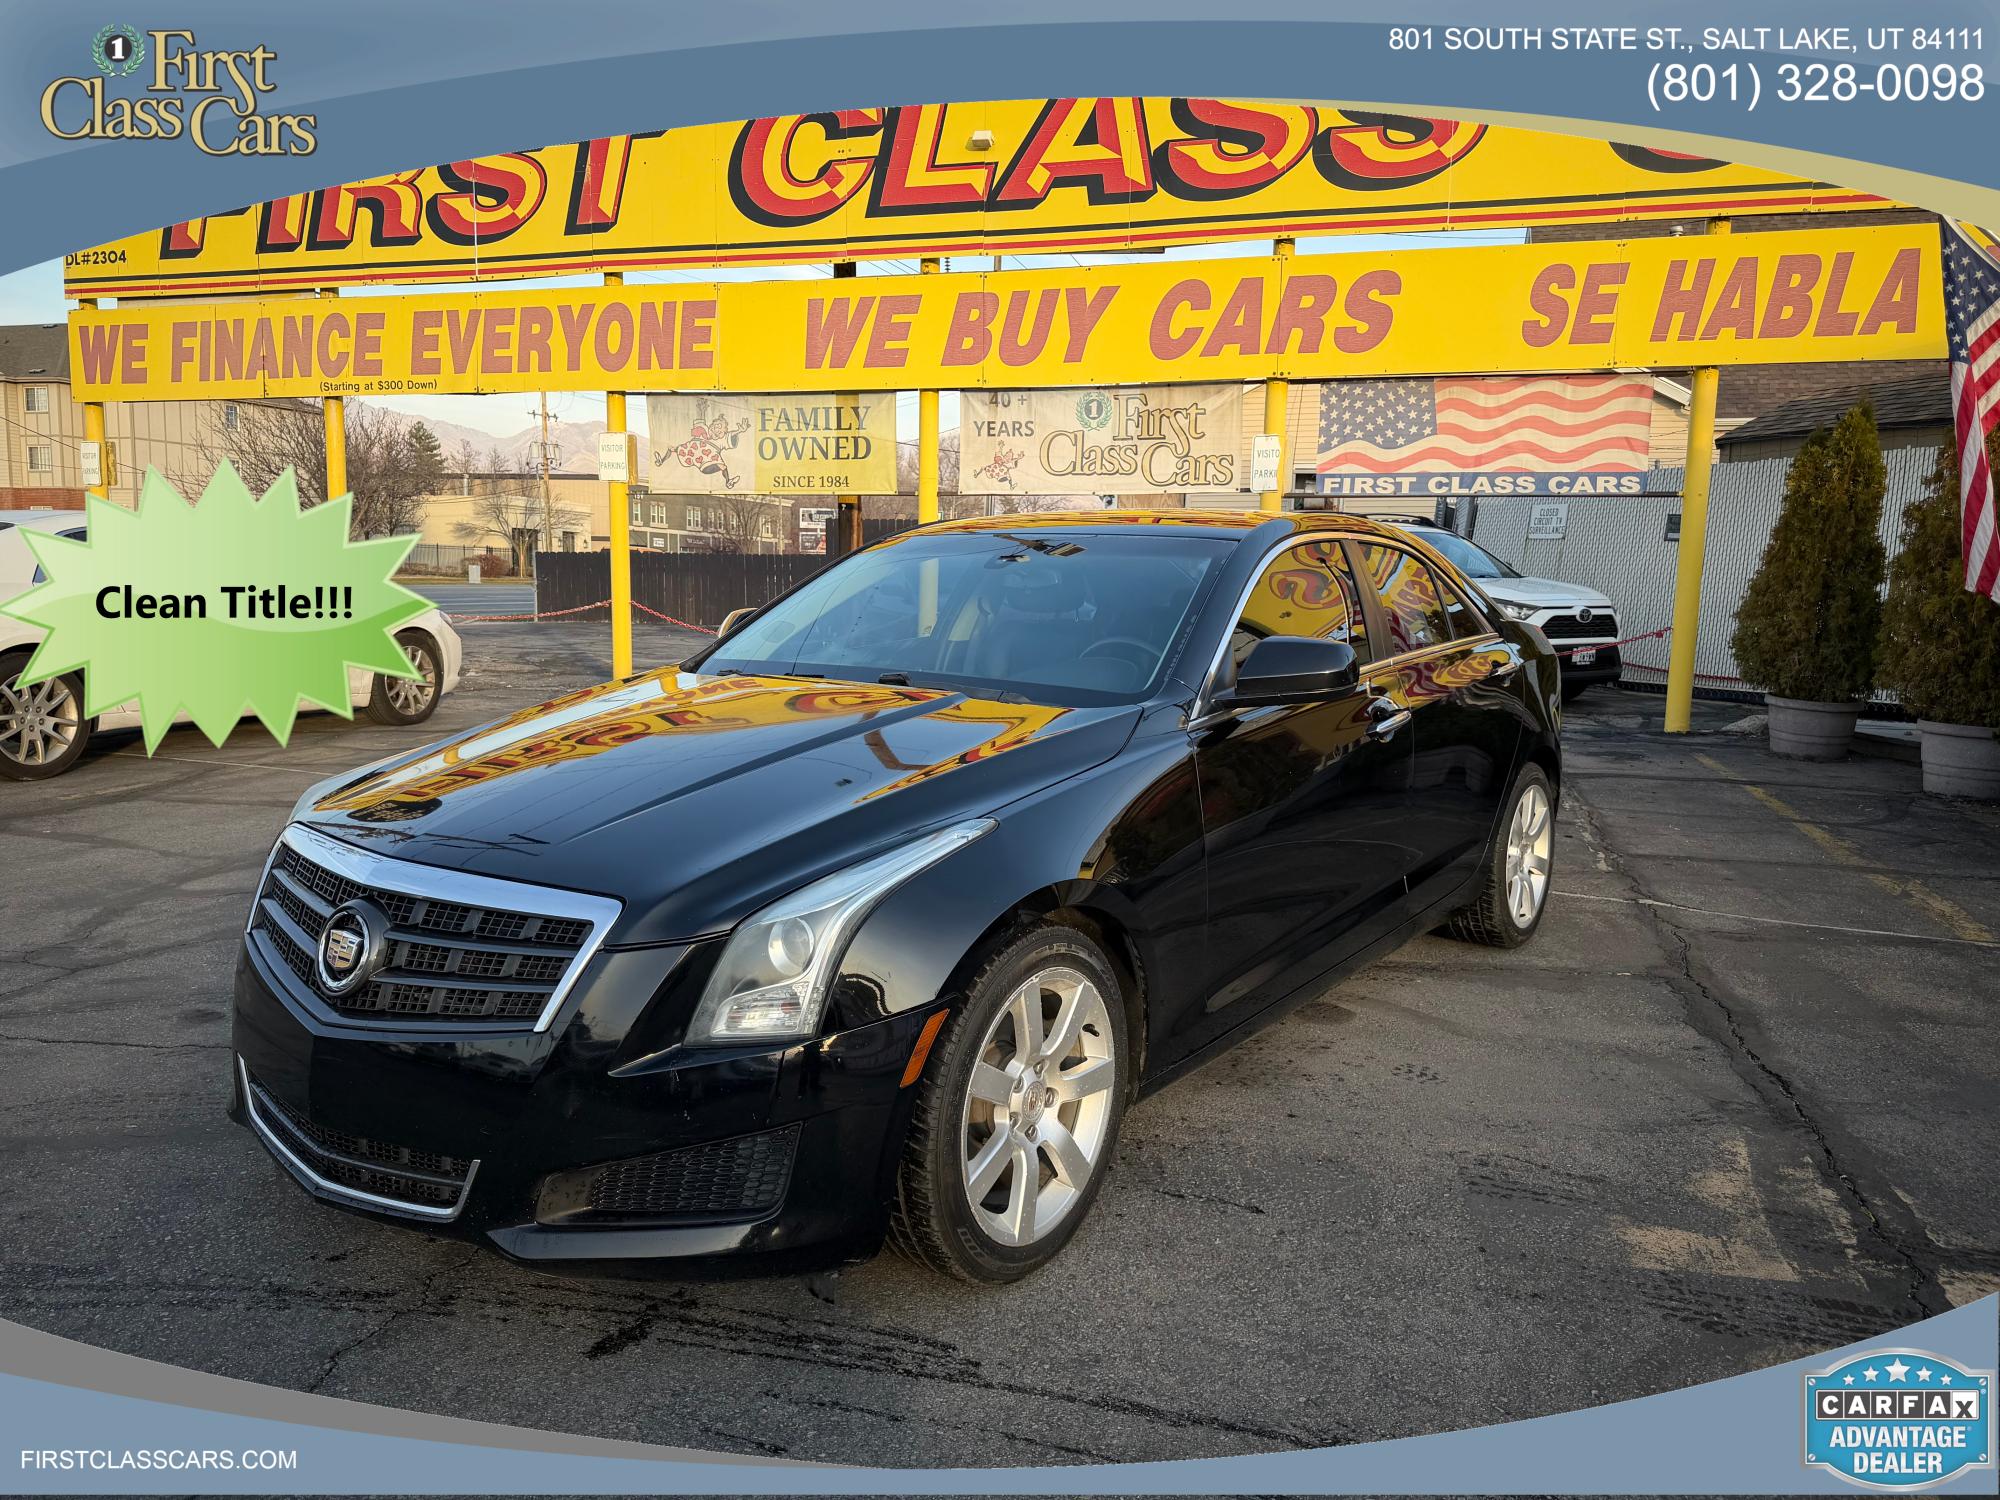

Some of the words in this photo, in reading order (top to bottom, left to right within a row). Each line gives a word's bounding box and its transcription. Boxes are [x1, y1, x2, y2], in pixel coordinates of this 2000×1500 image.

[1522, 263, 1630, 347] SE
[1650, 248, 1921, 342] HABLA
[805, 295, 922, 369] WE
[941, 286, 1119, 367] BUY
[1149, 270, 1402, 359] CARS
[80, 324, 148, 385] WE
[172, 313, 386, 382] FINANCE
[411, 301, 717, 376] EVERYONE
[320, 381, 360, 392] (Starting
[364, 381, 374, 391] at
[377, 380, 403, 391] $300
[407, 378, 438, 391] Down)
[758, 406, 871, 432] FAMILY
[974, 420, 1034, 437] YEARS
[1112, 392, 1206, 458] First
[758, 436, 872, 461] OWNED
[1039, 429, 1138, 476] Class
[1142, 441, 1233, 486] Cars
[773, 476, 815, 488] SINCE
[819, 475, 850, 488] 1984
[1323, 477, 1416, 494] FIRST
[1428, 476, 1536, 494] CLASS
[1548, 476, 1641, 494] CARS
